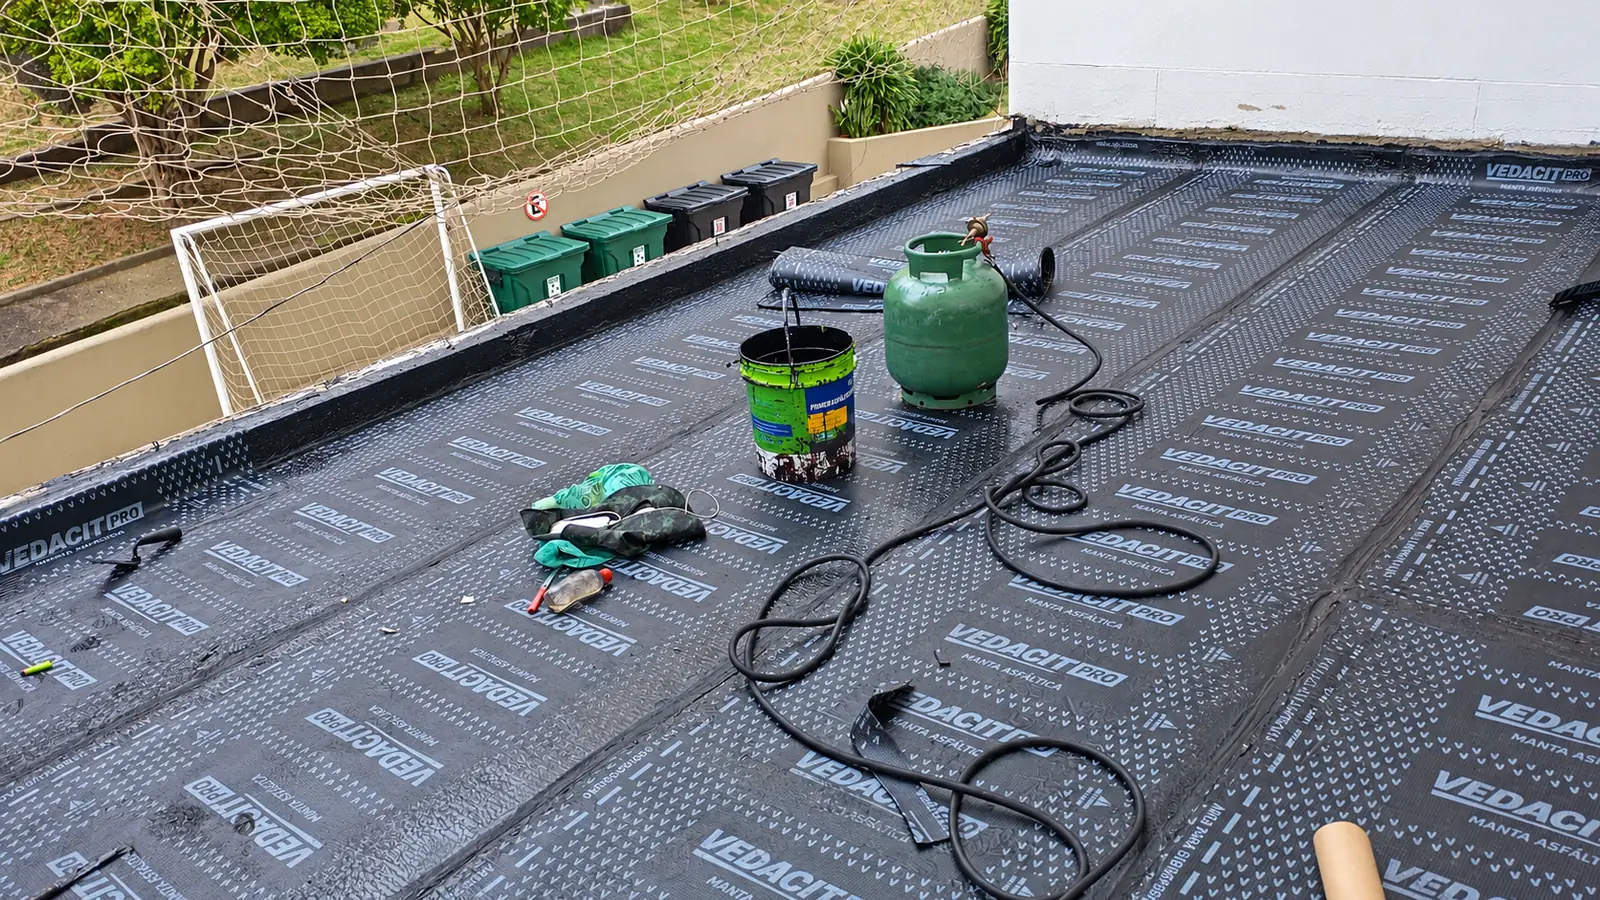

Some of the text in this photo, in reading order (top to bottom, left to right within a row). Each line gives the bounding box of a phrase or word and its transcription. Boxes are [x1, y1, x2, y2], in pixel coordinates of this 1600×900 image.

[1487, 163, 1590, 181] VEDACIT PRO
[1336, 308, 1430, 325] VEDACIT
[1307, 332, 1404, 350] VEDACIT
[1275, 357, 1376, 378] VEDACIT
[1240, 384, 1345, 407] VEDACIT
[518, 406, 586, 431] VEDACIT
[1202, 414, 1349, 446] VEDACIT PRO
[452, 435, 525, 465] VEDACIT
[1162, 448, 1313, 484] VEDACIT PRO
[380, 466, 452, 498] VEDACIT
[757, 480, 848, 513] VEDACIT
[108, 504, 142, 530] PRO
[300, 502, 373, 536] VEDACIT
[1116, 483, 1274, 525] VEDACIT PRO
[1133, 502, 1225, 529] MANTA ASFÁLTICA
[210, 540, 284, 578] VEDACIT
[1078, 531, 1187, 562] EDACIT
[1081, 547, 1176, 578] MANTA ASFÁLTICA
[112, 582, 205, 635] VEDACIT PRO
[1025, 596, 1124, 630] MANTA ASFÁLTICA
[1134, 606, 1179, 624] PRO
[1530, 608, 1586, 626] PRO
[949, 623, 1123, 685] VEDACIT PRO
[416, 652, 540, 716] VEDACIT PRO
[961, 652, 1063, 692] MANTA ASFÁLTICA
[310, 710, 436, 787] VEDACIT PRO
[889, 716, 984, 758] MANTA ASFÁLTIC
[1511, 732, 1568, 756] MANTA
[189, 778, 232, 802] PRO
[1434, 770, 1600, 842] VEDACI
[1468, 815, 1531, 842] MANTA
